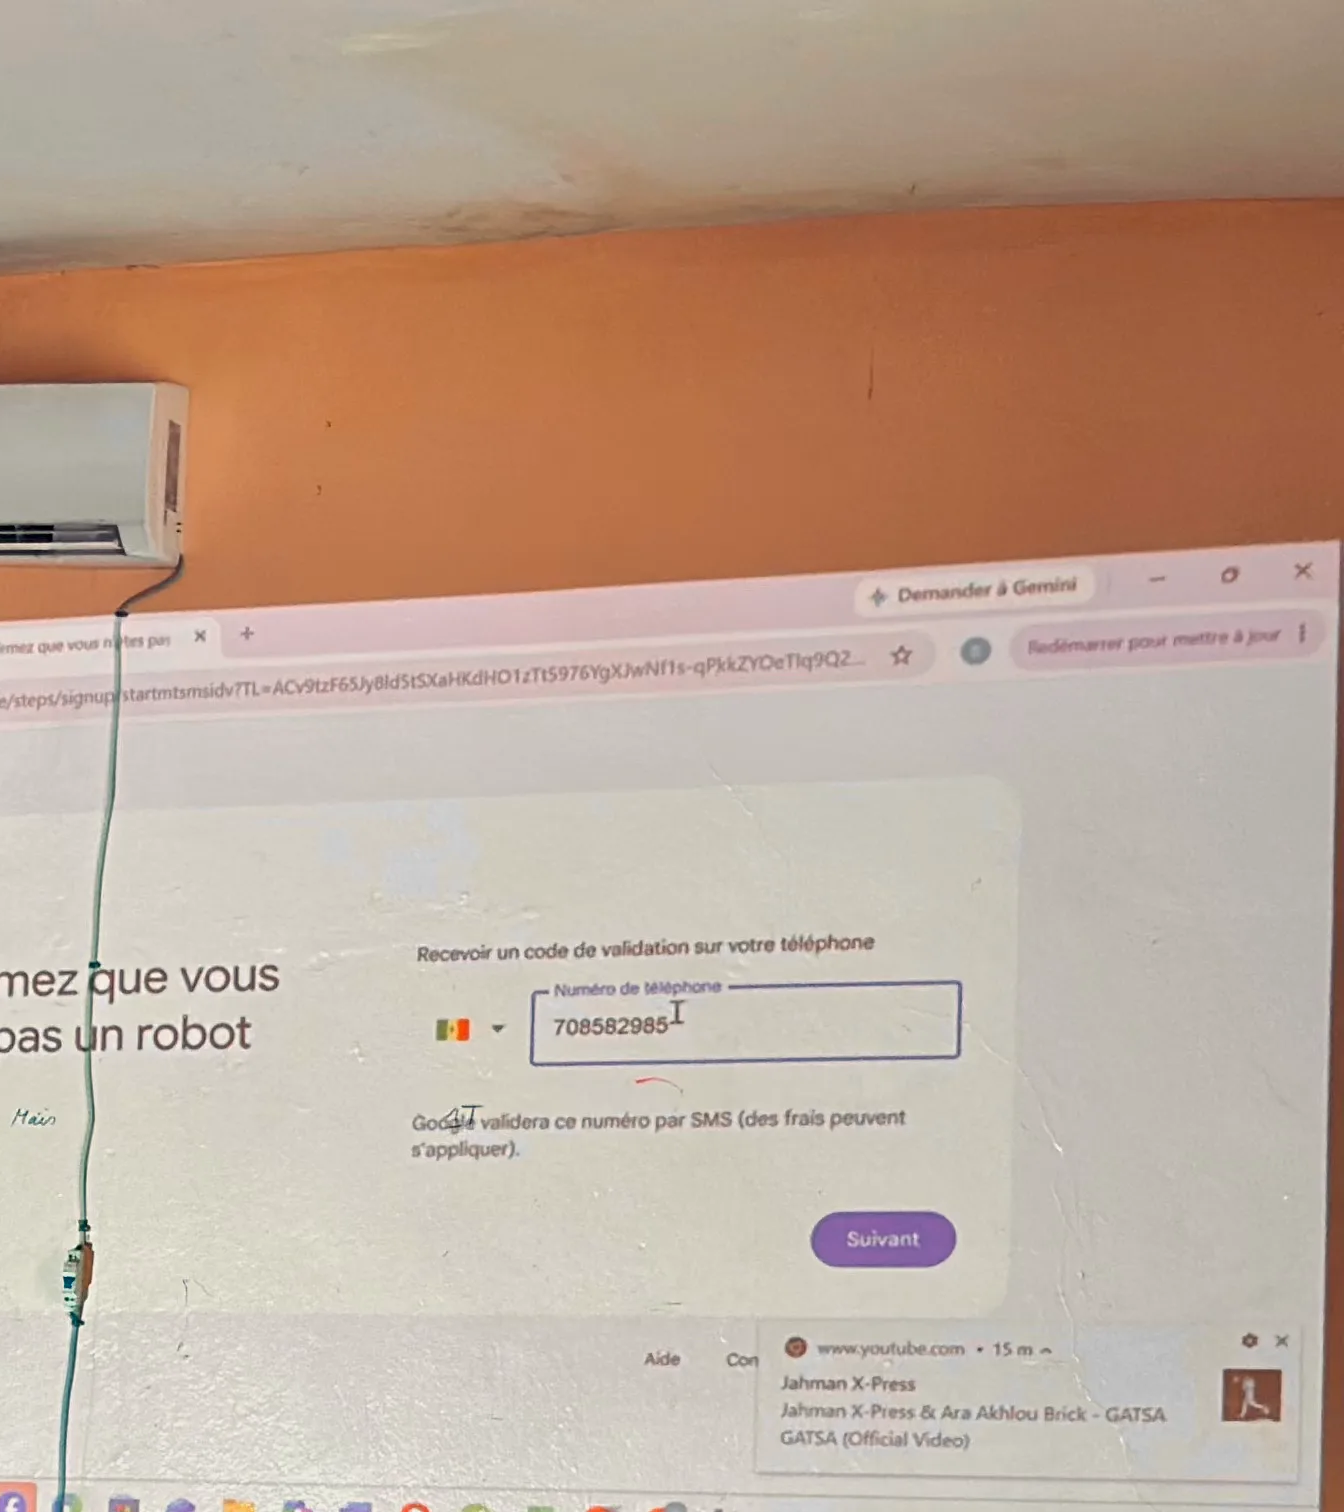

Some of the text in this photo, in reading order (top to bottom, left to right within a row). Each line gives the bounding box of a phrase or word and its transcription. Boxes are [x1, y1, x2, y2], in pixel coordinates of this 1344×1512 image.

[898, 582, 992, 602] Demander
[1013, 576, 1077, 595] Gemini
[38, 640, 64, 655] que
[67, 639, 99, 651] vous
[417, 933, 876, 962] Recevoir un code de validation sur votre téléphone
[91, 965, 169, 1005] que
[179, 962, 280, 993] vous
[554, 979, 723, 998] Numéro de téléphone
[75, 1020, 123, 1053] un
[137, 1015, 252, 1052] robot
[553, 1015, 669, 1037] 708582985
[481, 1112, 550, 1130] validera
[554, 1116, 577, 1130] ce
[581, 1111, 651, 1130] numéro
[655, 1113, 685, 1133] par
[691, 1111, 733, 1129] SMS
[738, 1109, 779, 1130] (des
[784, 1108, 825, 1127] frais
[830, 1109, 906, 1131] peuvent
[411, 1140, 520, 1161] s'appliquer).
[846, 1229, 921, 1248] Suivant
[644, 1351, 681, 1367] Aide
[817, 1340, 1033, 1359] www.youtube.com 15 m
[780, 1375, 917, 1393] Jahman X-Press
[780, 1402, 847, 1419] Jahman
[851, 1403, 914, 1420] X-Press
[920, 1404, 936, 1420] &
[941, 1405, 971, 1421] Ara
[976, 1405, 1039, 1422] Akhlou
[1044, 1405, 1088, 1423] Brick
[1105, 1406, 1167, 1423] GATSA
[780, 1430, 971, 1450] GATSA (Official Video)
